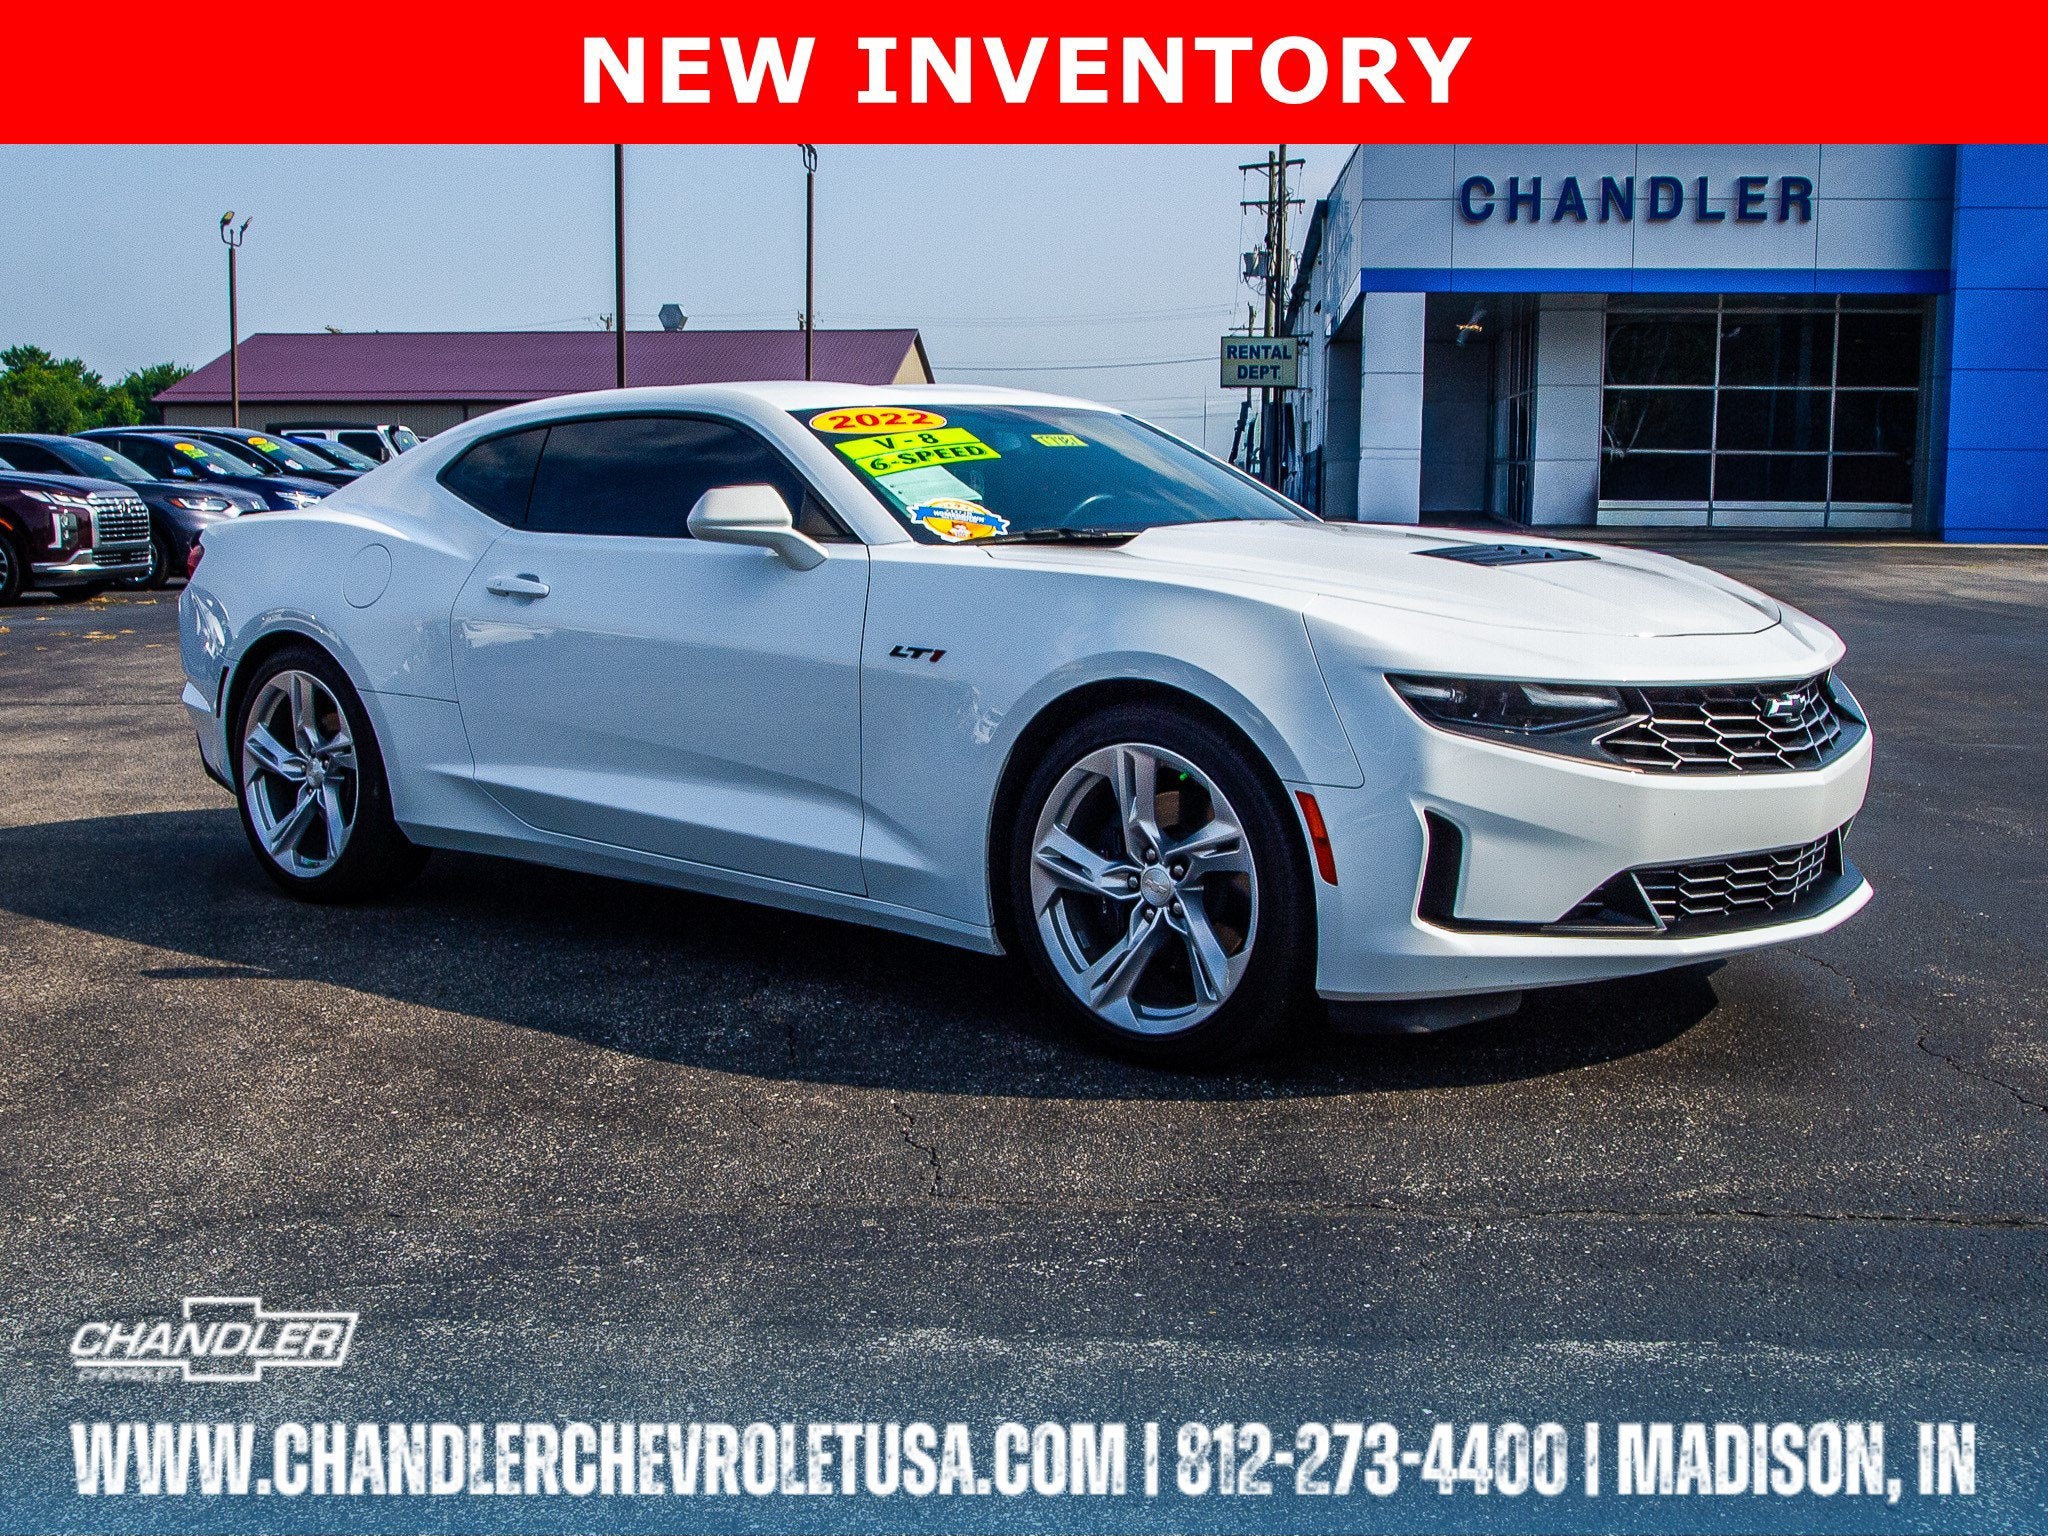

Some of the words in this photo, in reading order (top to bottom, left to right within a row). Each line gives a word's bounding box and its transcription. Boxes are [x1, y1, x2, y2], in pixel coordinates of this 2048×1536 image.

[1458, 175, 1815, 223] CHANDLER
[1226, 344, 1293, 360] RENTAL
[1237, 364, 1282, 380] DEPT.
[828, 412, 934, 431] 2022
[870, 445, 986, 471] 6-SPEED
[889, 644, 947, 664] LT1
